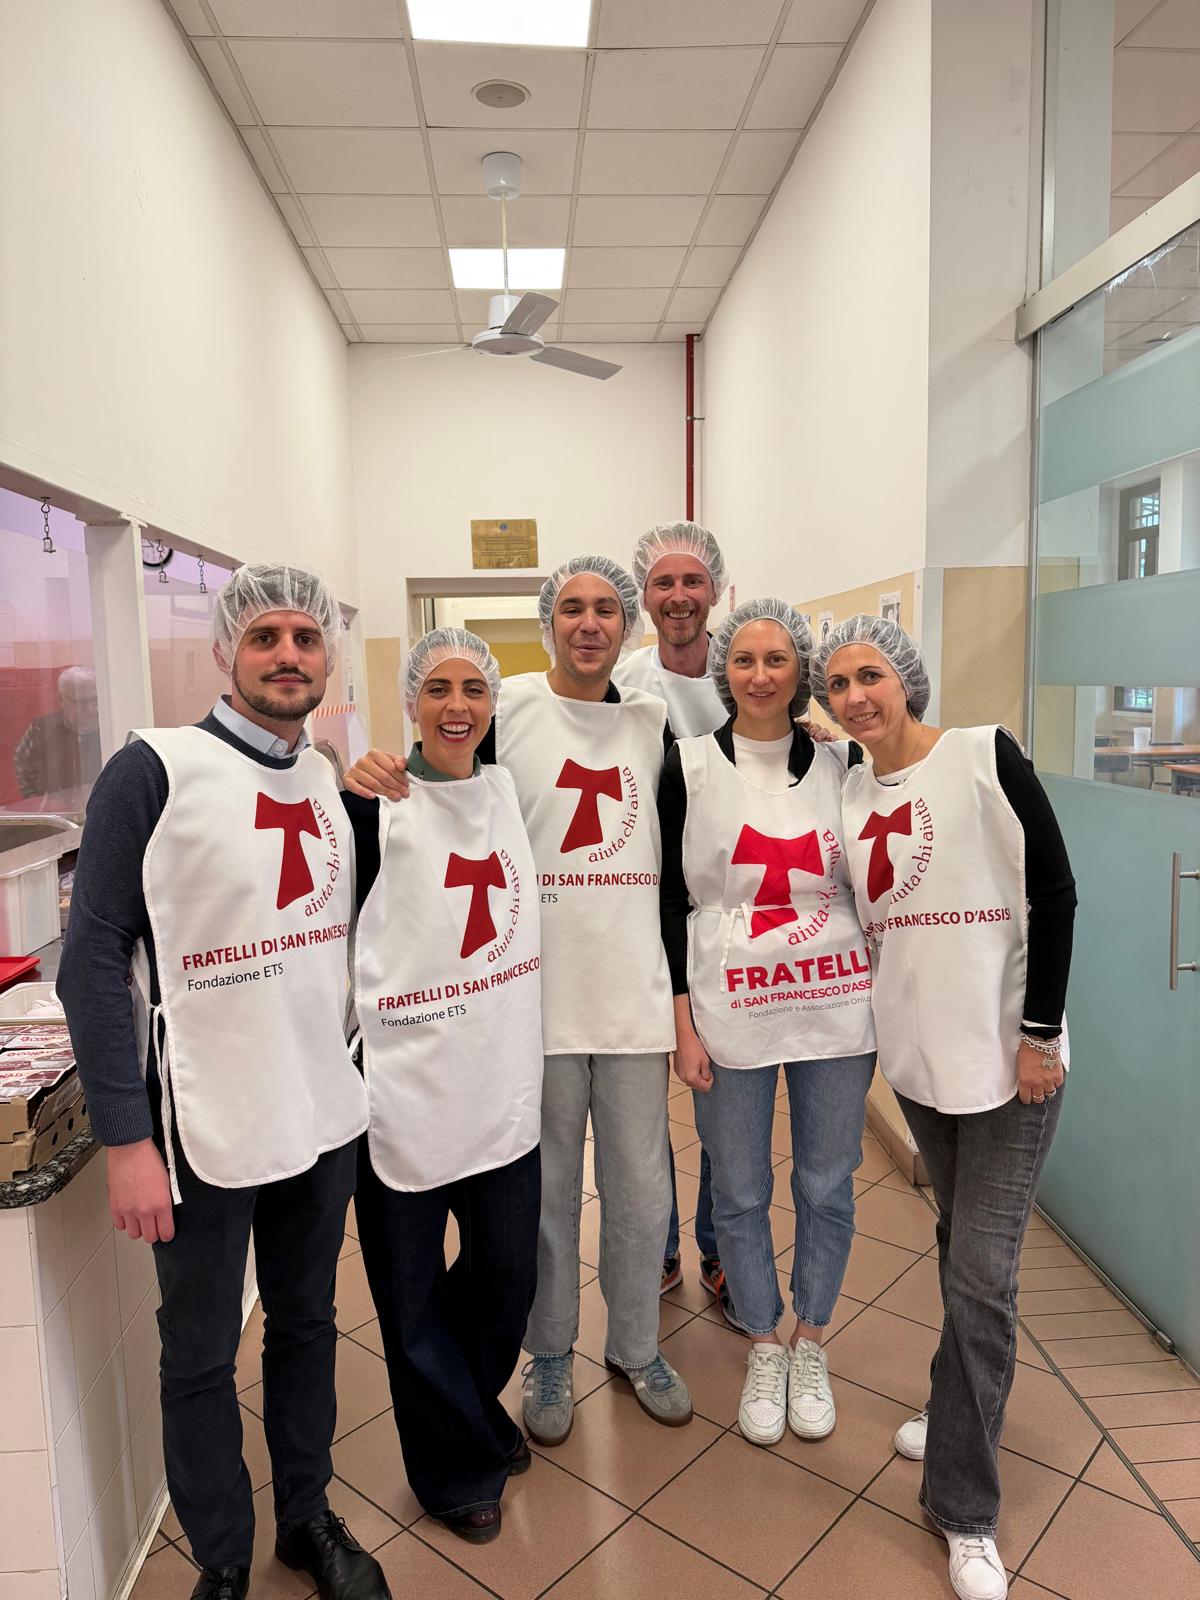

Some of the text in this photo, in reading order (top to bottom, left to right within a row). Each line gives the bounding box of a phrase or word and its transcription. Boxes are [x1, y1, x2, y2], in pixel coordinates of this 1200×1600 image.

[588, 766, 639, 863] aiuta chi aiuta
[304, 798, 341, 917] aiuta chi aiuta
[890, 797, 934, 904] iuta chi aiuta
[542, 874, 555, 886] DI
[558, 873, 584, 886] SAN
[587, 872, 651, 886] FRANCESCO
[487, 848, 520, 963] aiuta chi aiuta
[541, 893, 558, 903] ETS
[787, 911, 829, 946] aiuta
[888, 912, 961, 930] FRANCESCO
[182, 942, 257, 971] FRATELLI
[262, 937, 279, 956] DI
[280, 932, 307, 951] SAN
[187, 962, 284, 992] Fondazione ETS
[378, 956, 541, 1011] FRATELLI DI SAN FRANCESCO
[730, 998, 741, 1009] di
[744, 994, 768, 1008] SAN
[770, 987, 839, 1005] FRANCESCO
[748, 1005, 794, 1020] Fondazione
[801, 998, 850, 1011] Associazione
[381, 1003, 467, 1027] Fondazione ETS
